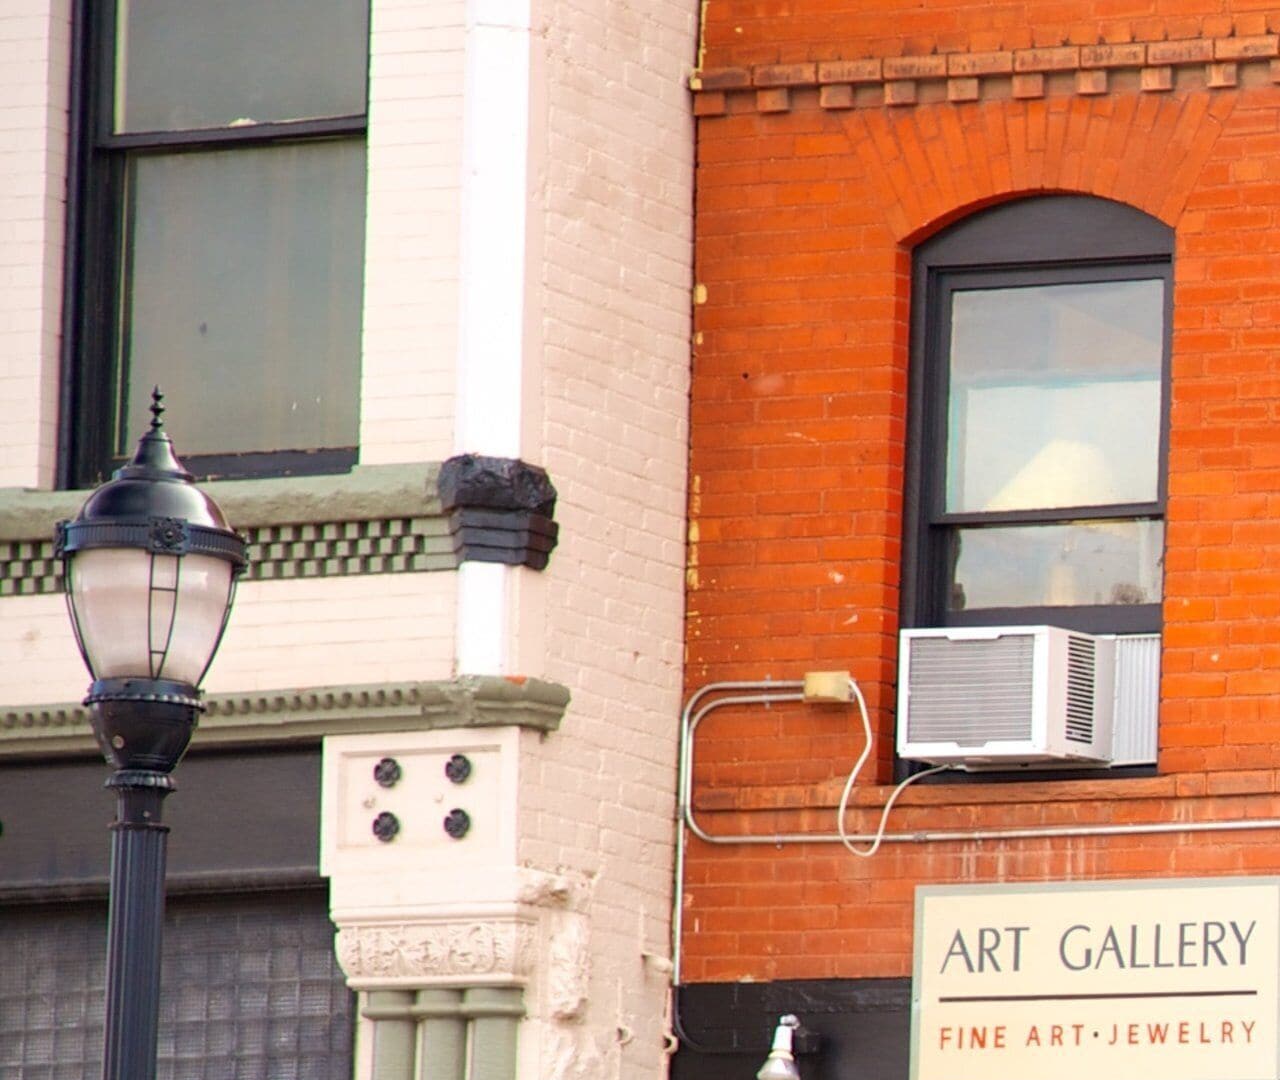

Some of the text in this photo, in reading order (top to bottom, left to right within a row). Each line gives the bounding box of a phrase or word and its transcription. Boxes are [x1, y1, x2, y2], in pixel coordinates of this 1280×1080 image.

[940, 920, 1258, 975] ART GALLERY
[939, 1024, 1006, 1051] FINE
